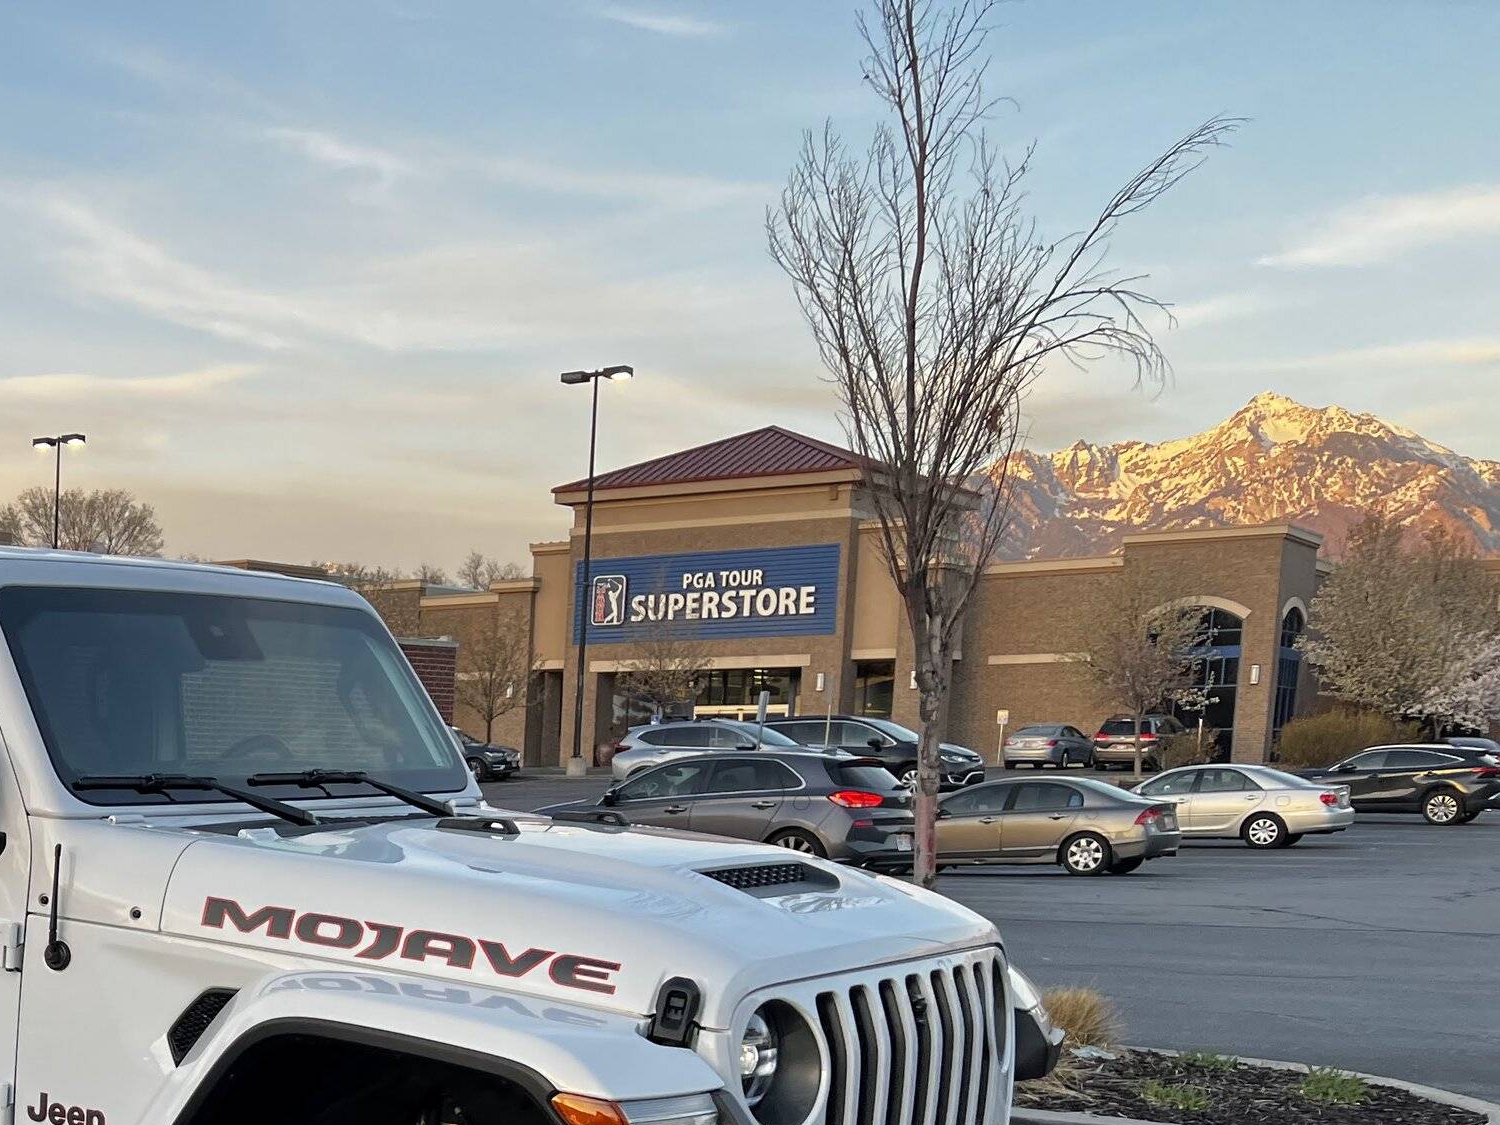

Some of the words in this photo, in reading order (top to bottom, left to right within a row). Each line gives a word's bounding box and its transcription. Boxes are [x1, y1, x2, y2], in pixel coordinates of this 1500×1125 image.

[683, 572, 716, 589] PGA
[720, 569, 763, 587] TOUR
[630, 586, 815, 622] SUPERSTORE
[201, 896, 621, 995] MOJAVE
